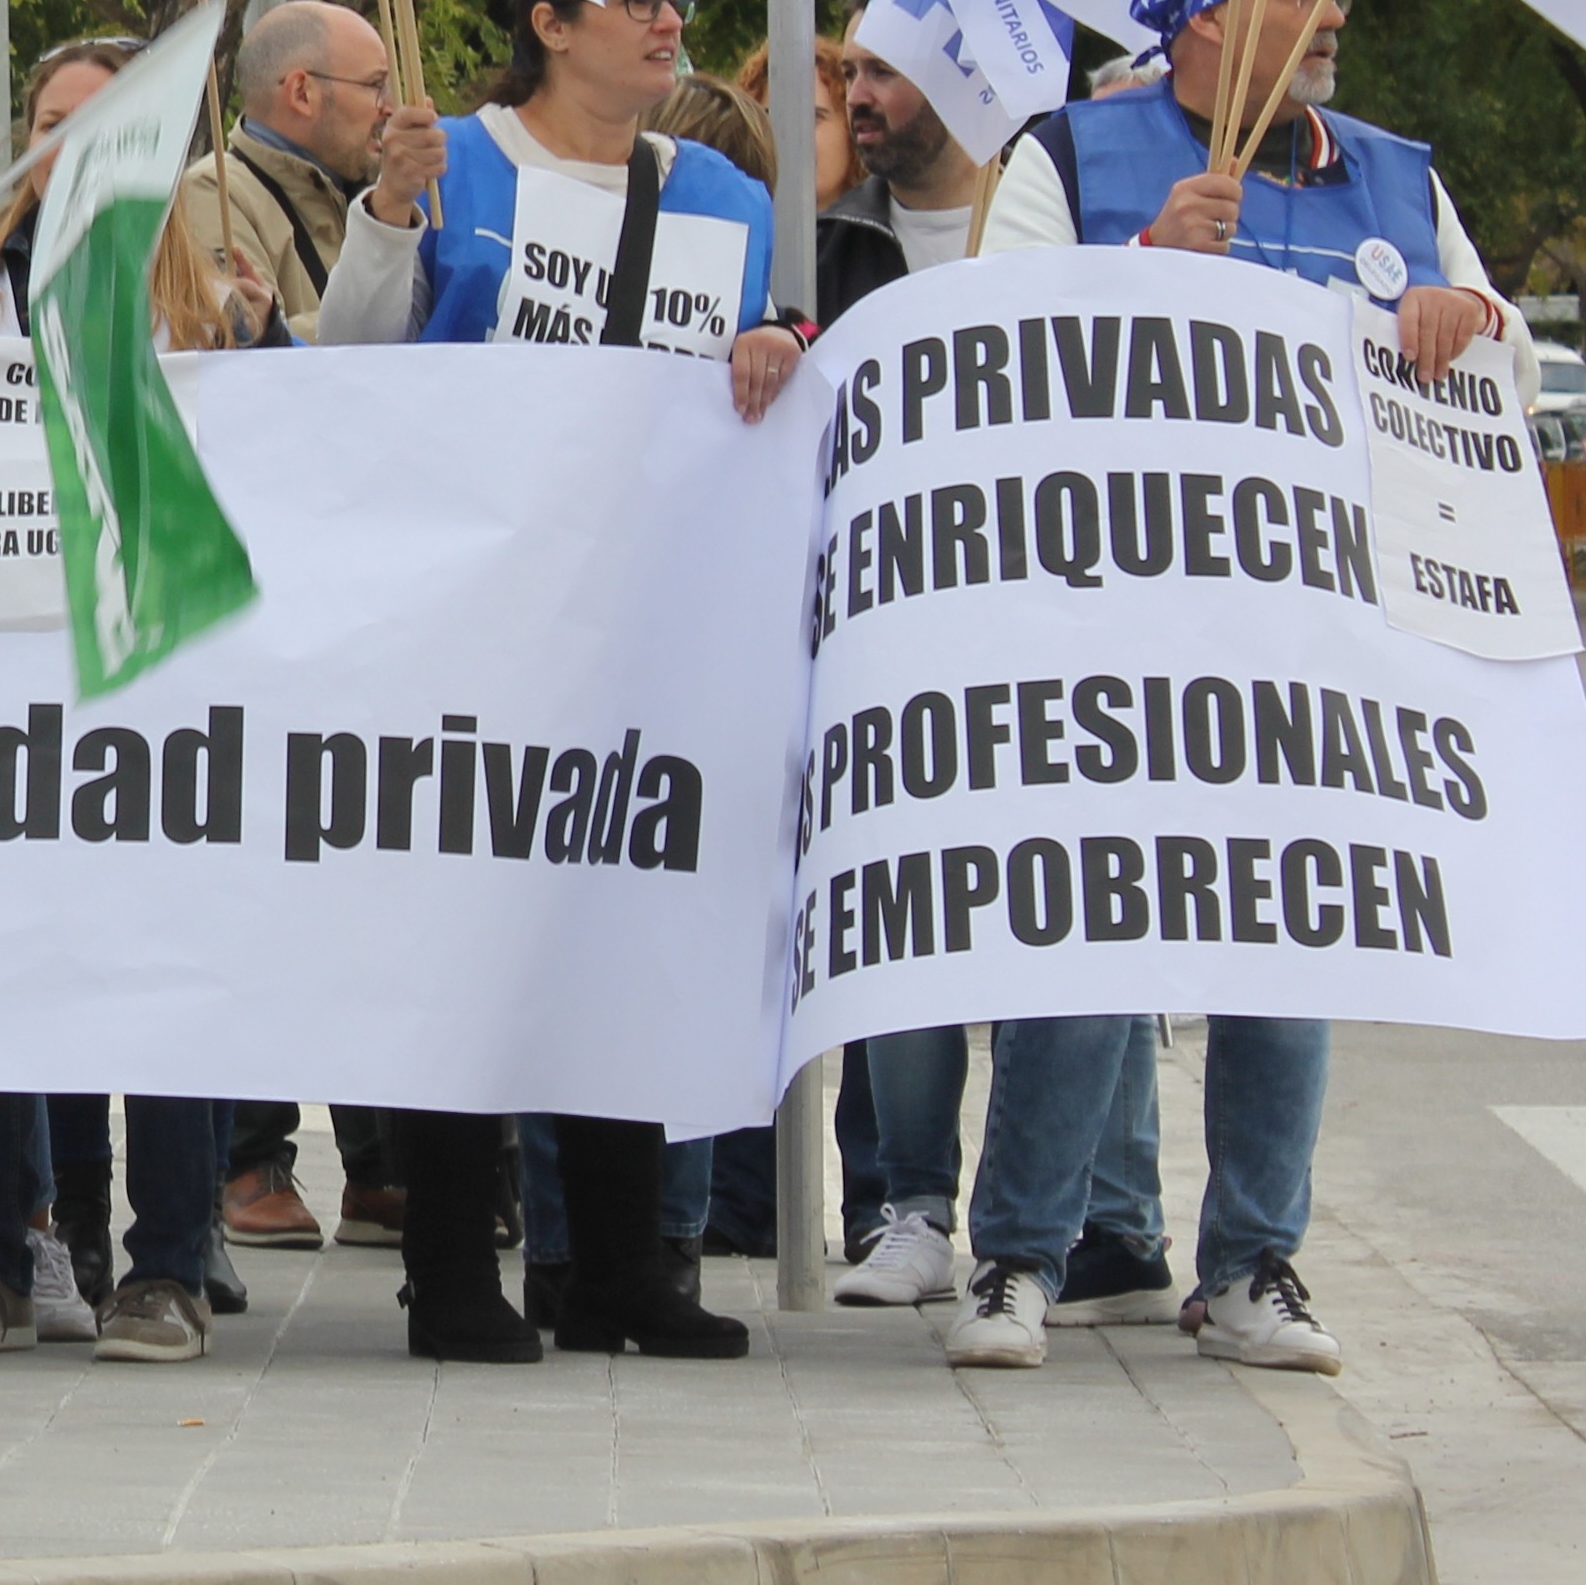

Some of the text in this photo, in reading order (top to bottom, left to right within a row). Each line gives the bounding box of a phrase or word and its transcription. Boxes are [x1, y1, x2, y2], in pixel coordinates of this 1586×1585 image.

[512, 297, 593, 346] MÁS
[524, 242, 592, 297] SOY
[650, 286, 727, 337] 10%
[901, 314, 1346, 448] PRIVADAS
[1369, 391, 1524, 474] COLECTIVO
[847, 469, 1379, 619] ENRIQUECEN
[1410, 552, 1519, 616] ESTAFA
[284, 713, 702, 873] privada
[820, 673, 1489, 832] PROFESIONALES
[827, 834, 1454, 980] EMPOBRECEN
